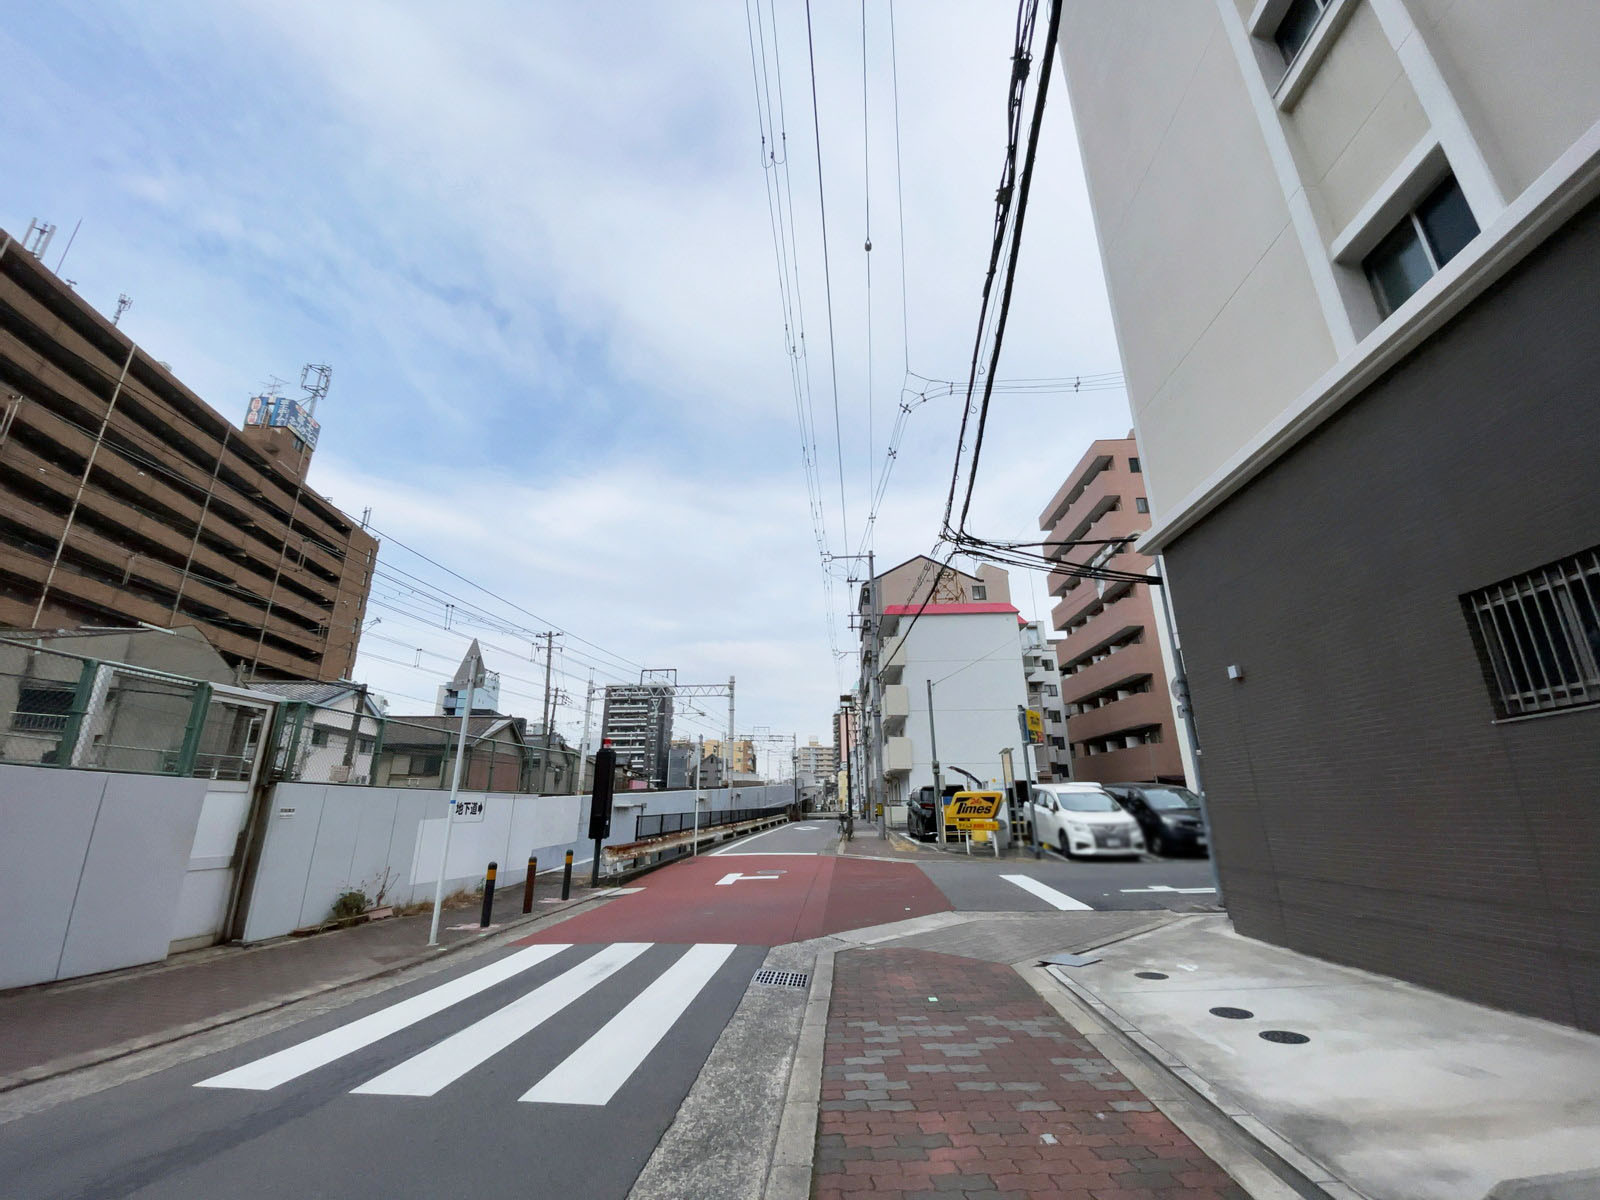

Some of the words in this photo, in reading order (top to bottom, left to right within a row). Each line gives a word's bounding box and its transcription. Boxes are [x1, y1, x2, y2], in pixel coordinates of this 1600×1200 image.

[456, 802, 478, 815] 地下道
[957, 802, 992, 814] Times
